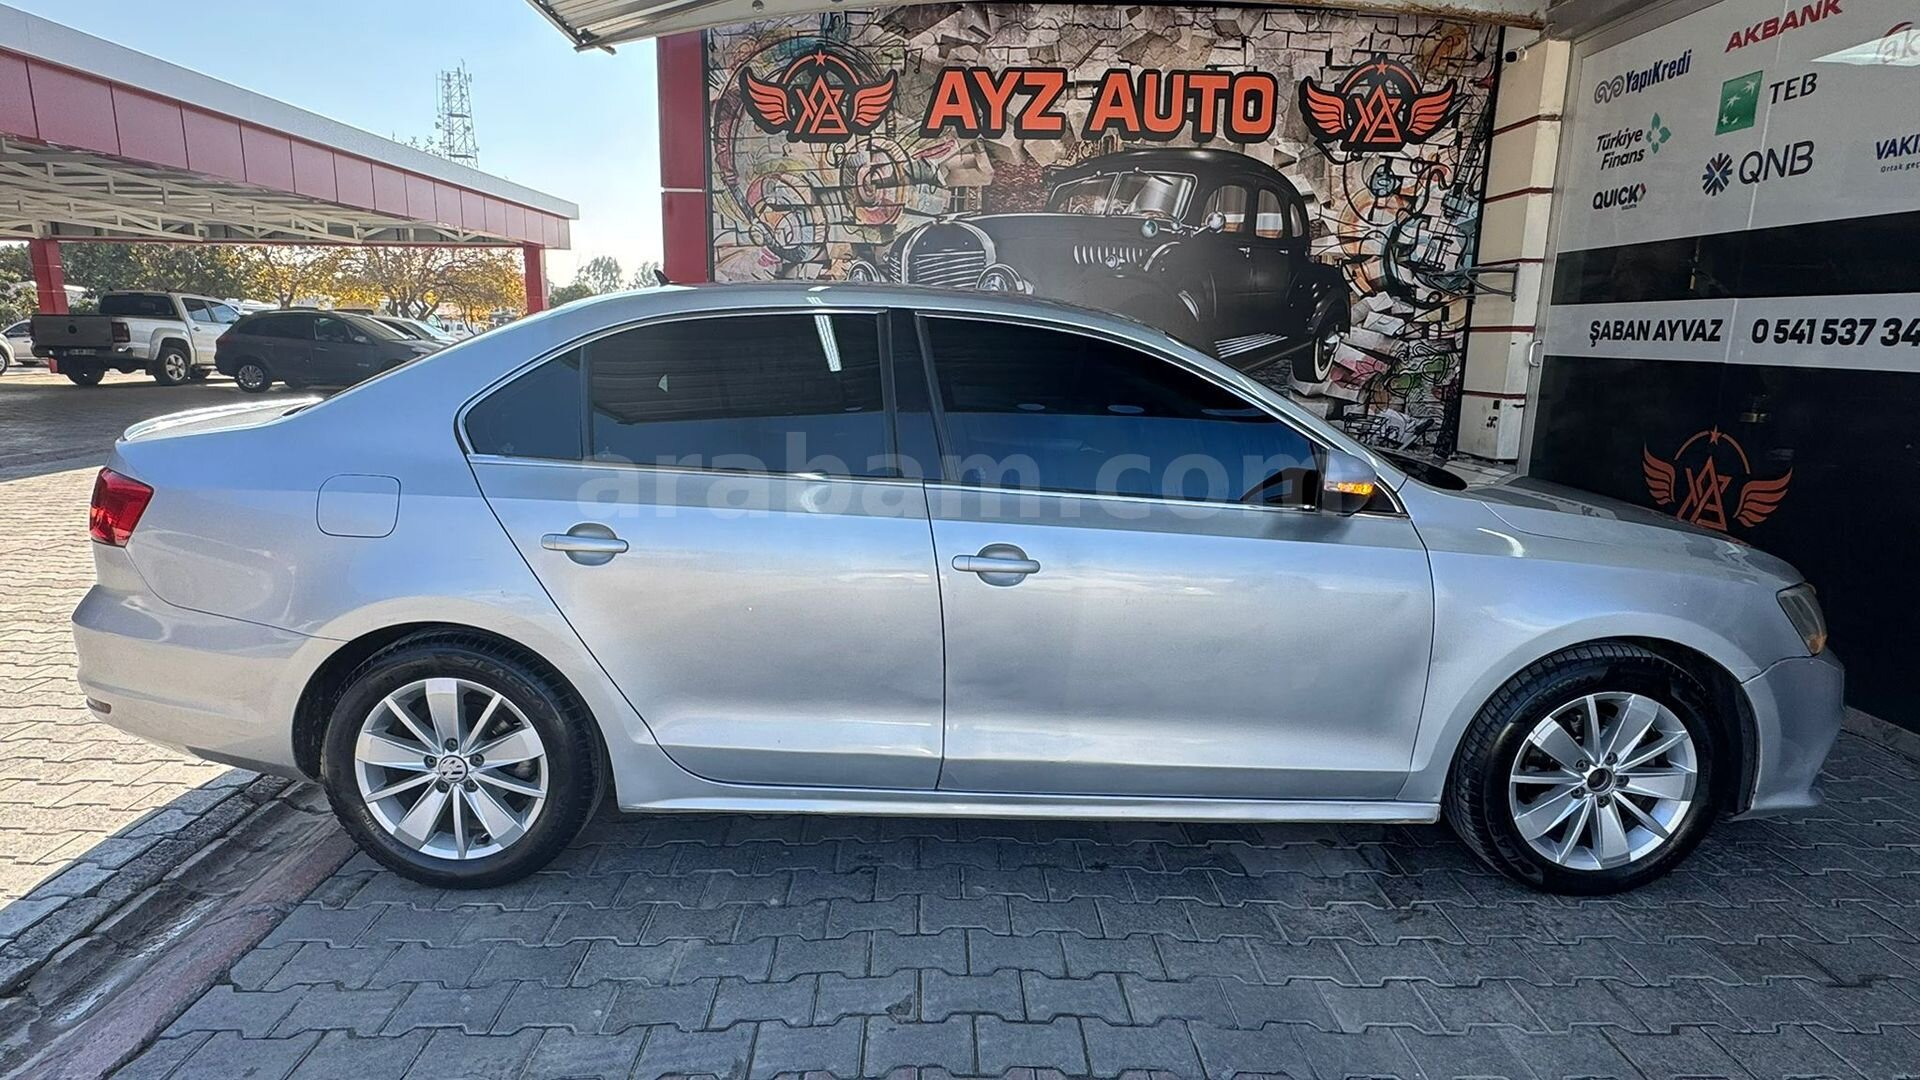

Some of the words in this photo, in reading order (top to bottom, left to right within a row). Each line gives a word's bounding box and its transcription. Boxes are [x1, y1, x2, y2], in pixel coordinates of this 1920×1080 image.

[1725, 0, 1842, 53] AKBANK
[922, 68, 1066, 137] AYZ
[1085, 70, 1277, 139] AUTO
[1769, 73, 1817, 105] TEB
[1597, 128, 1643, 153] Türkiye
[1876, 134, 1920, 160] VAKI
[1600, 148, 1645, 171] Finans
[1739, 140, 1814, 185] QNB
[1592, 183, 1640, 210] QUICK
[1590, 320, 1650, 347] ŞABAN
[1652, 319, 1723, 342] AYVAZ
[1773, 318, 1816, 344] 541
[1820, 317, 1877, 346] 537
[1880, 317, 1920, 347] 34
